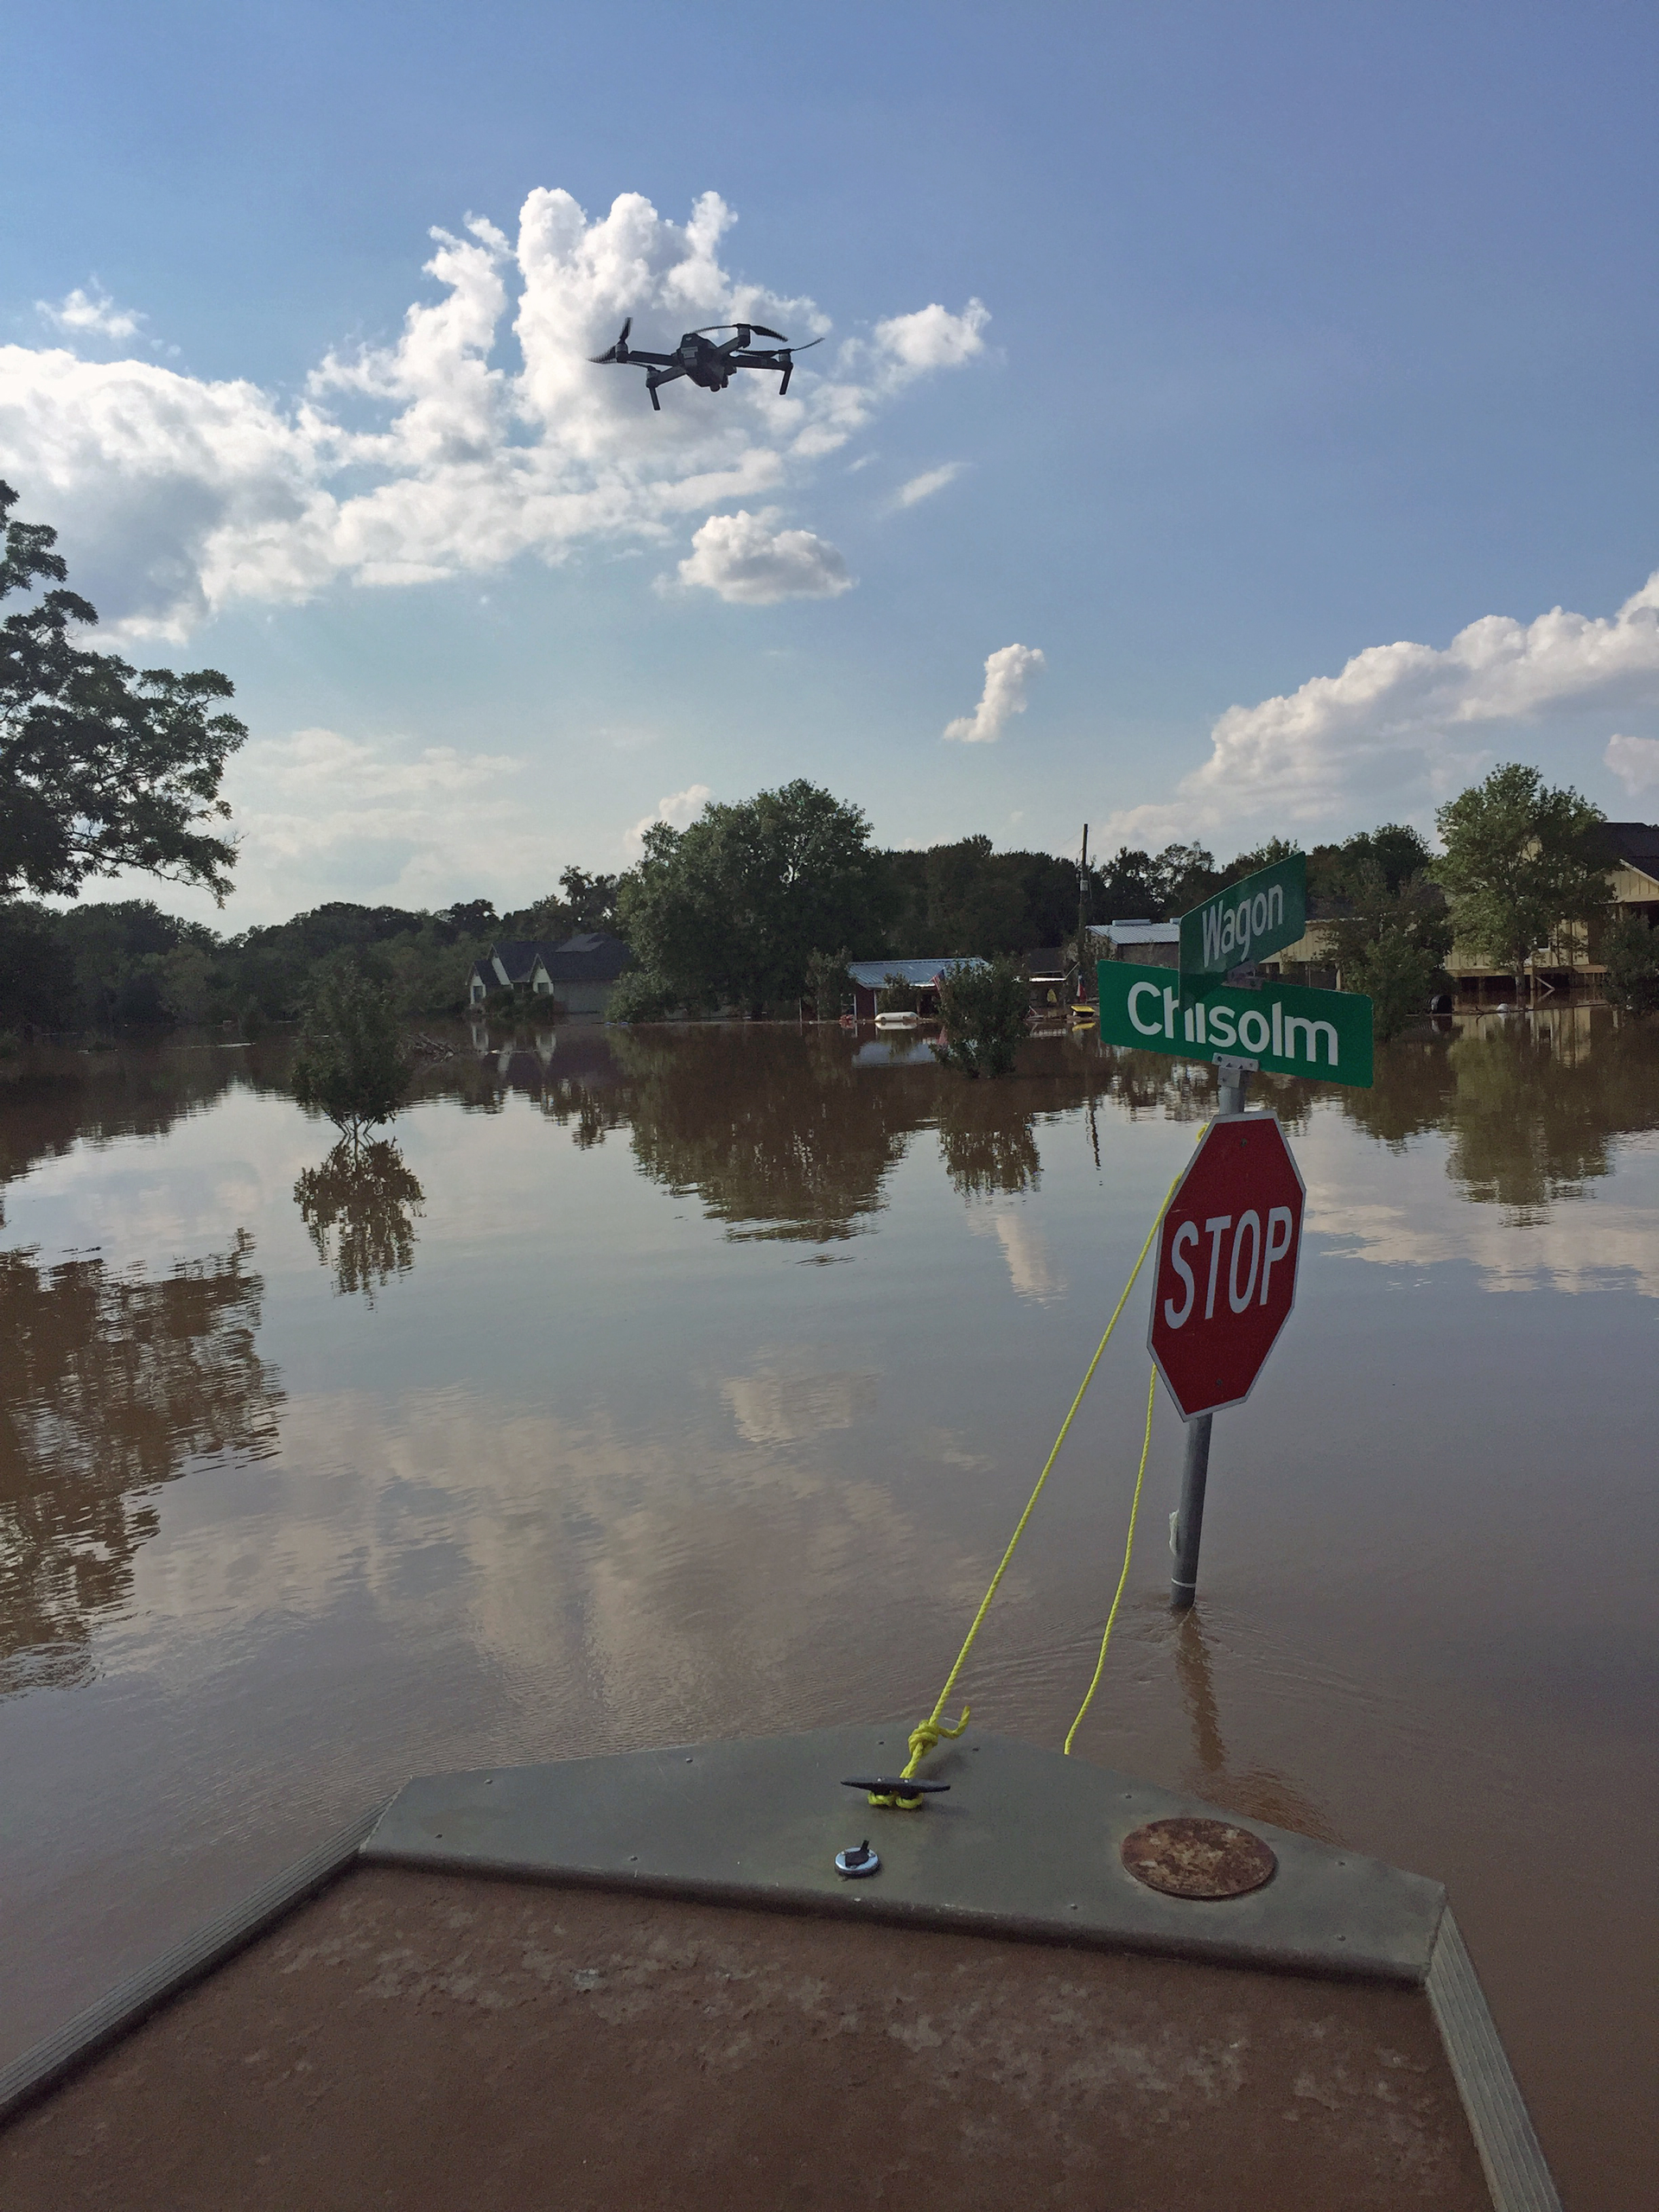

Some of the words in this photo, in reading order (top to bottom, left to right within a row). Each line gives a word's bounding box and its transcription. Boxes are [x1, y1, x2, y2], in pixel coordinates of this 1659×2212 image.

[1202, 884, 1283, 968] Wagon
[1128, 982, 1338, 1065] Chisolm
[1165, 1206, 1292, 1329] STOP
